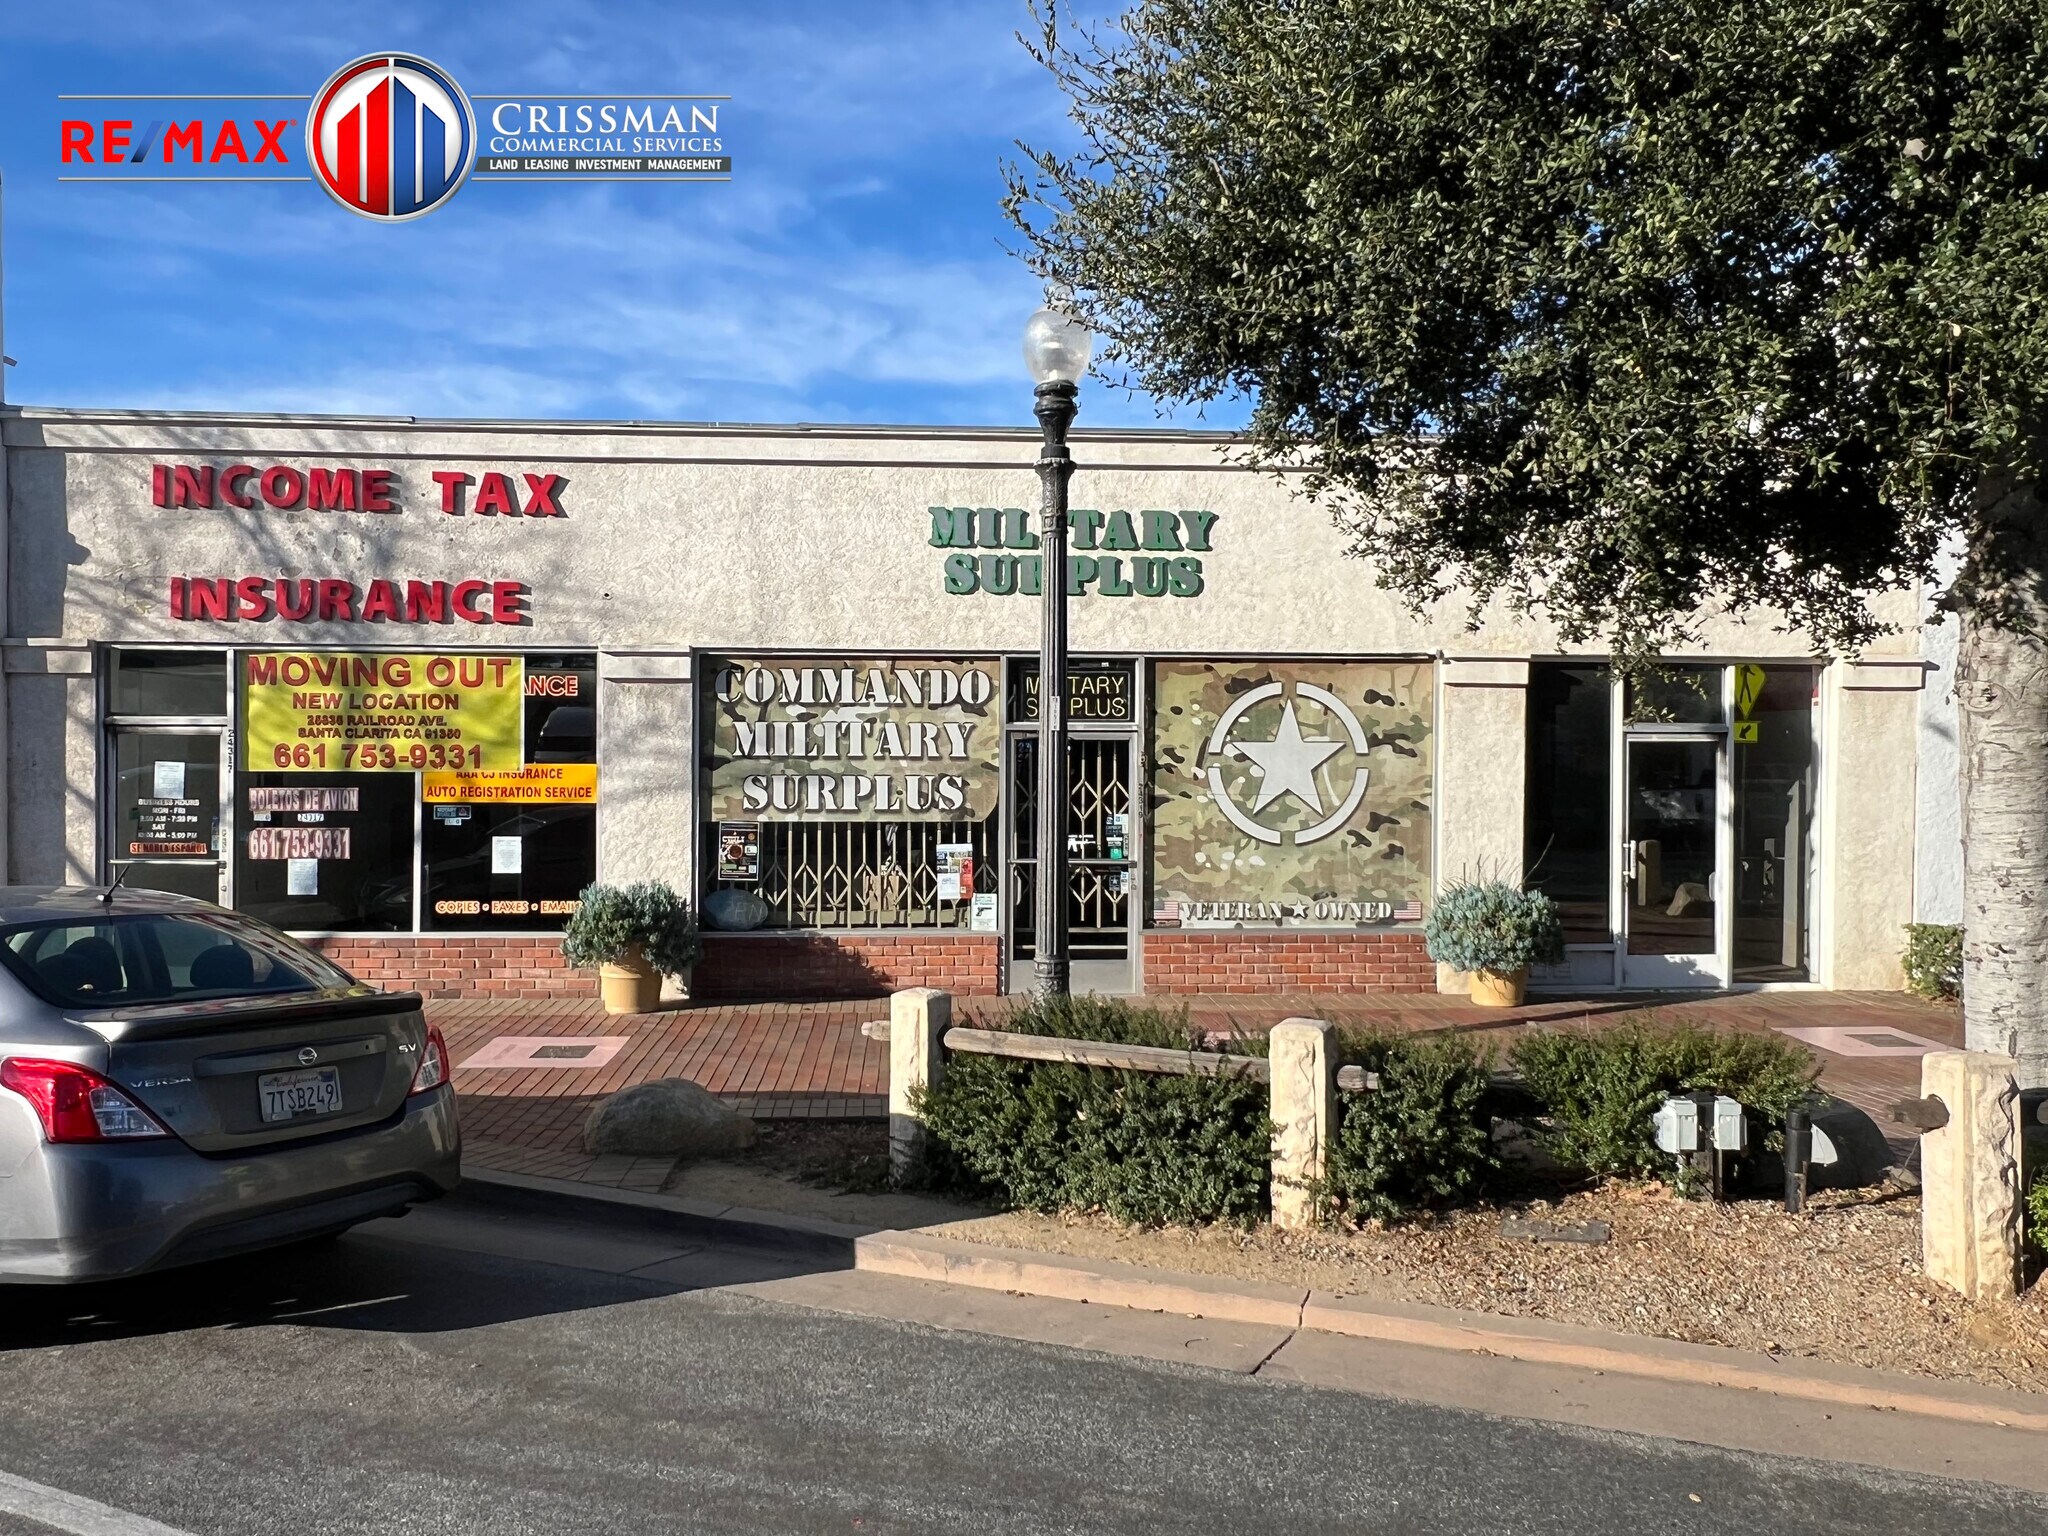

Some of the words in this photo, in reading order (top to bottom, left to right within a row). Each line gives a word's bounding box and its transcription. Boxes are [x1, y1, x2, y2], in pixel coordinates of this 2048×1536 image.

[152, 464, 396, 512] INCOME
[432, 471, 562, 515] TAX
[928, 506, 1219, 551] MILTARY
[170, 576, 526, 625] INSURANCE
[249, 656, 412, 688] MOVING
[426, 656, 512, 688] OUT
[715, 667, 992, 705] COMMANDO
[1026, 676, 1124, 695] MTARY
[292, 692, 343, 710] NEW
[349, 693, 459, 710] LOCATION
[1025, 697, 1125, 717] SPLUS
[347, 715, 415, 726] RAILROAD
[298, 728, 341, 739] SANTA
[345, 728, 400, 739] CLARITA
[403, 728, 421, 739] CA
[731, 720, 976, 760] MILITARY
[273, 743, 326, 768] 661
[342, 744, 482, 769] 753-9331
[250, 789, 300, 811] BOLETOS
[304, 789, 319, 811] DE
[324, 789, 358, 811] AVION
[426, 786, 457, 798] AUTO
[460, 786, 542, 798] REGISTRATION
[544, 786, 593, 798] SERVICE
[741, 774, 967, 811] SURPLUS
[435, 901, 480, 914] COPIES
[491, 901, 529, 914] FAXES
[1183, 902, 1282, 920] VETERAN
[1314, 902, 1392, 920] OWNED
[398, 1043, 416, 1054] SV
[130, 1077, 191, 1089] VERSA
[266, 1084, 334, 1114] 7TSB249
